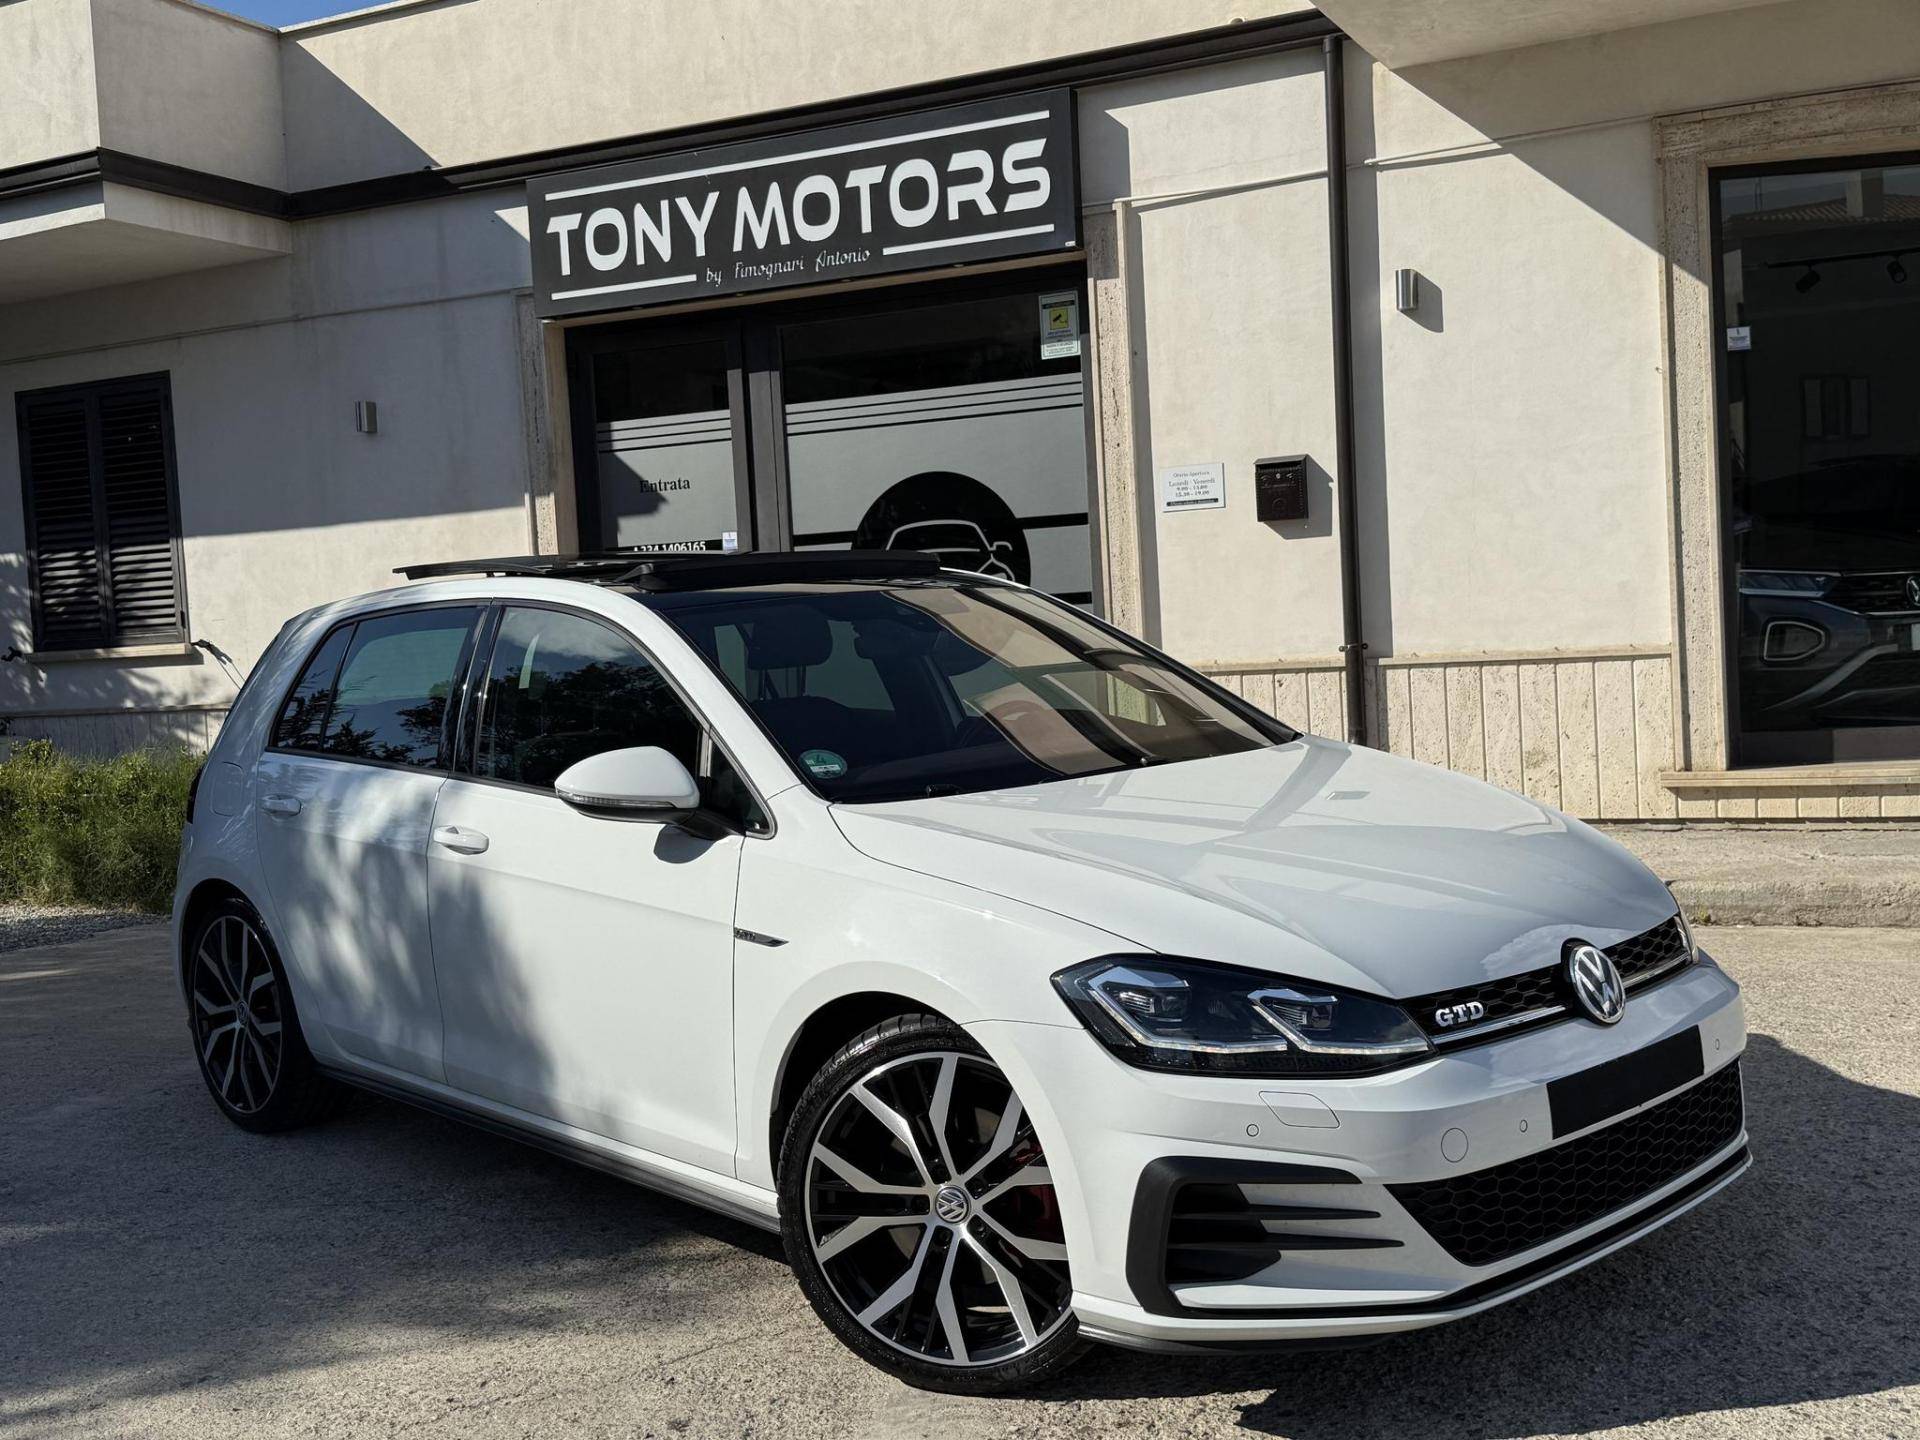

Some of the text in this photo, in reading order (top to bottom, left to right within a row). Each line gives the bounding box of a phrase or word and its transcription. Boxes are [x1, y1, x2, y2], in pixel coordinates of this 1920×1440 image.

[546, 137, 1052, 277] TONY MOTORS
[705, 267, 722, 287] by
[815, 247, 871, 272] Antonio
[639, 477, 691, 493] Entrata
[1434, 1000, 1484, 1027] GTD
